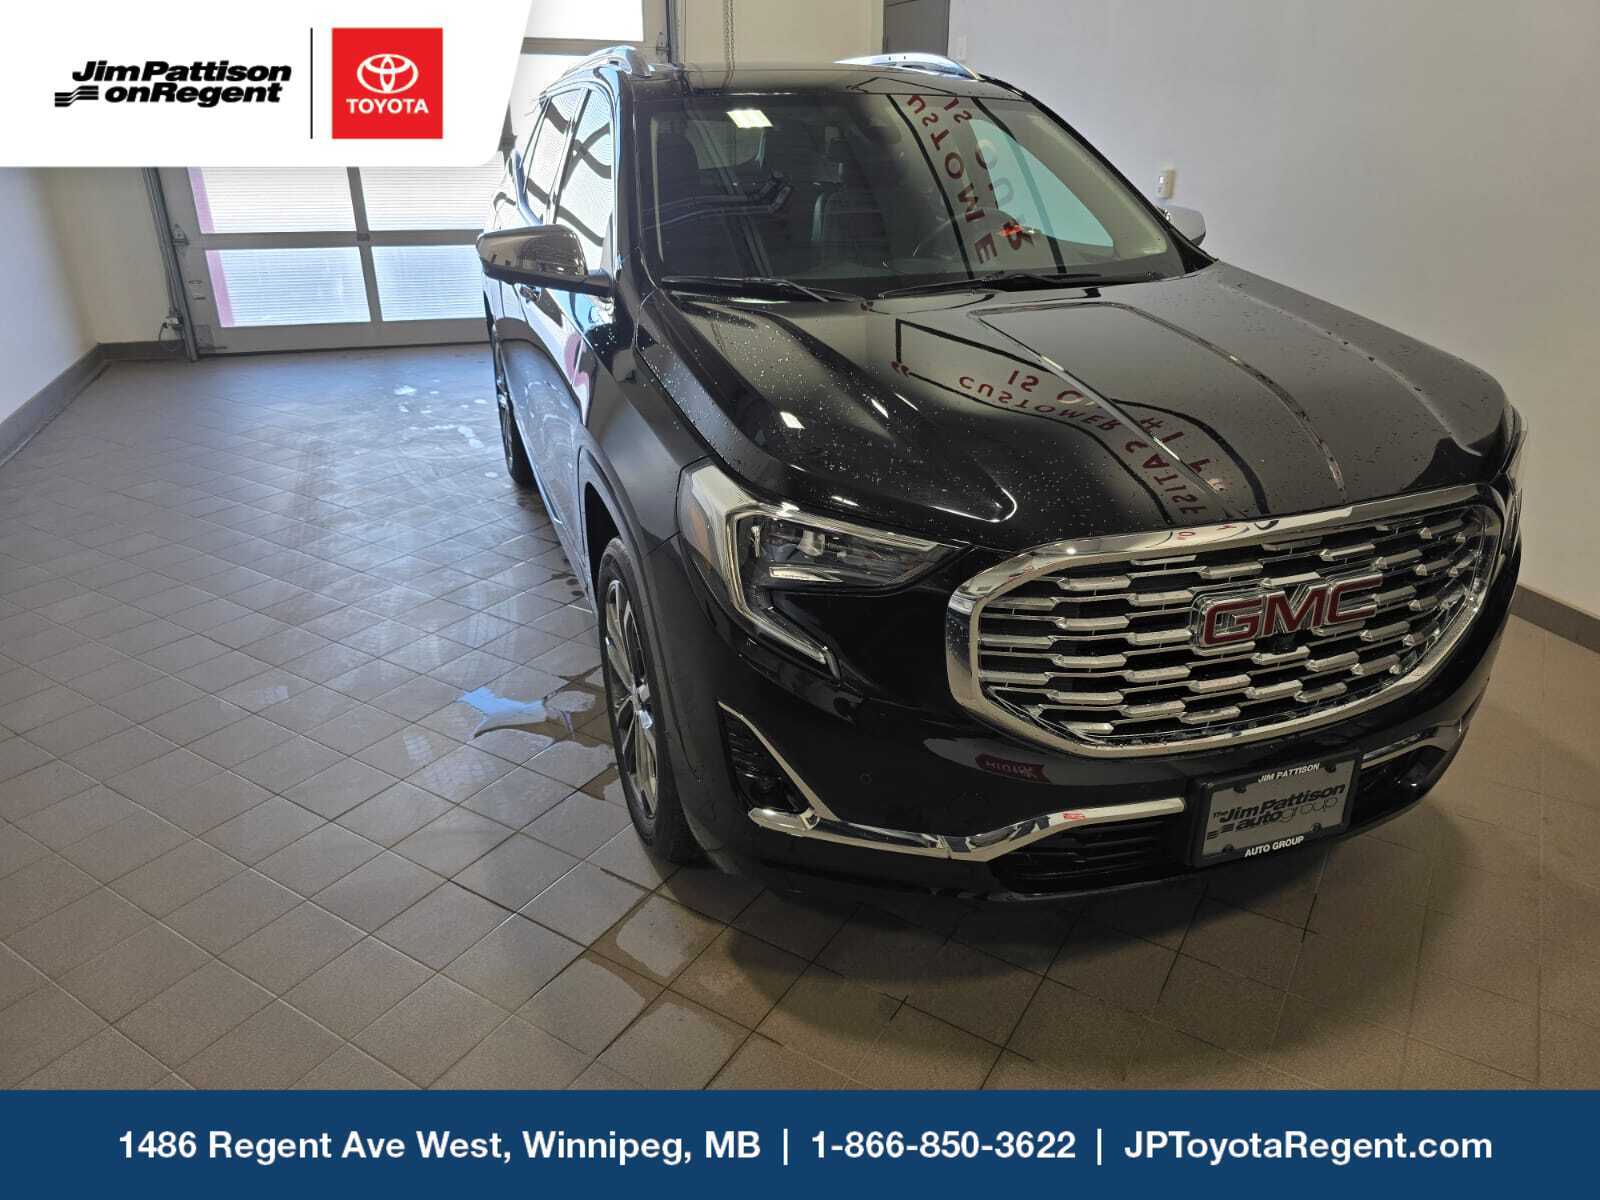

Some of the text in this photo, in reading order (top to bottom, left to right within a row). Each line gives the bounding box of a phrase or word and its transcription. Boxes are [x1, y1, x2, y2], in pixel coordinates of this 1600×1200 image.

[1202, 573, 1384, 646] GMC
[1258, 763, 1320, 783] JIM PATTISON
[1244, 835, 1305, 858] AUTO GROUP
